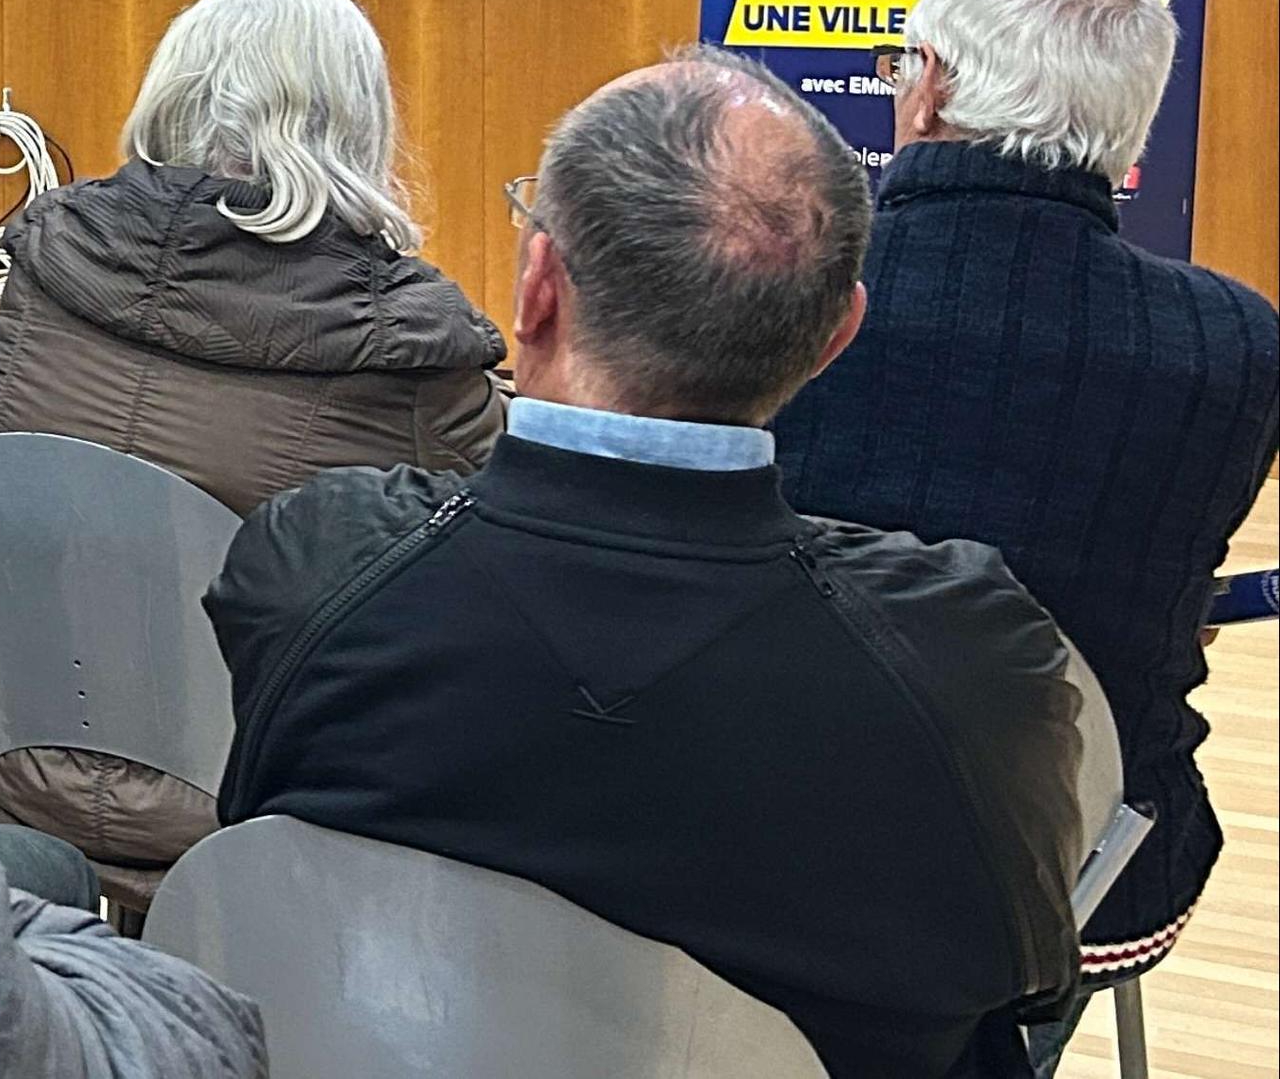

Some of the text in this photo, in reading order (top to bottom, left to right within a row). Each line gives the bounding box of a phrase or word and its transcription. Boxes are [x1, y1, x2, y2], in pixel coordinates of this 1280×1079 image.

[744, 4, 907, 34] UNE VILLE
[801, 76, 896, 95] avec EMM
